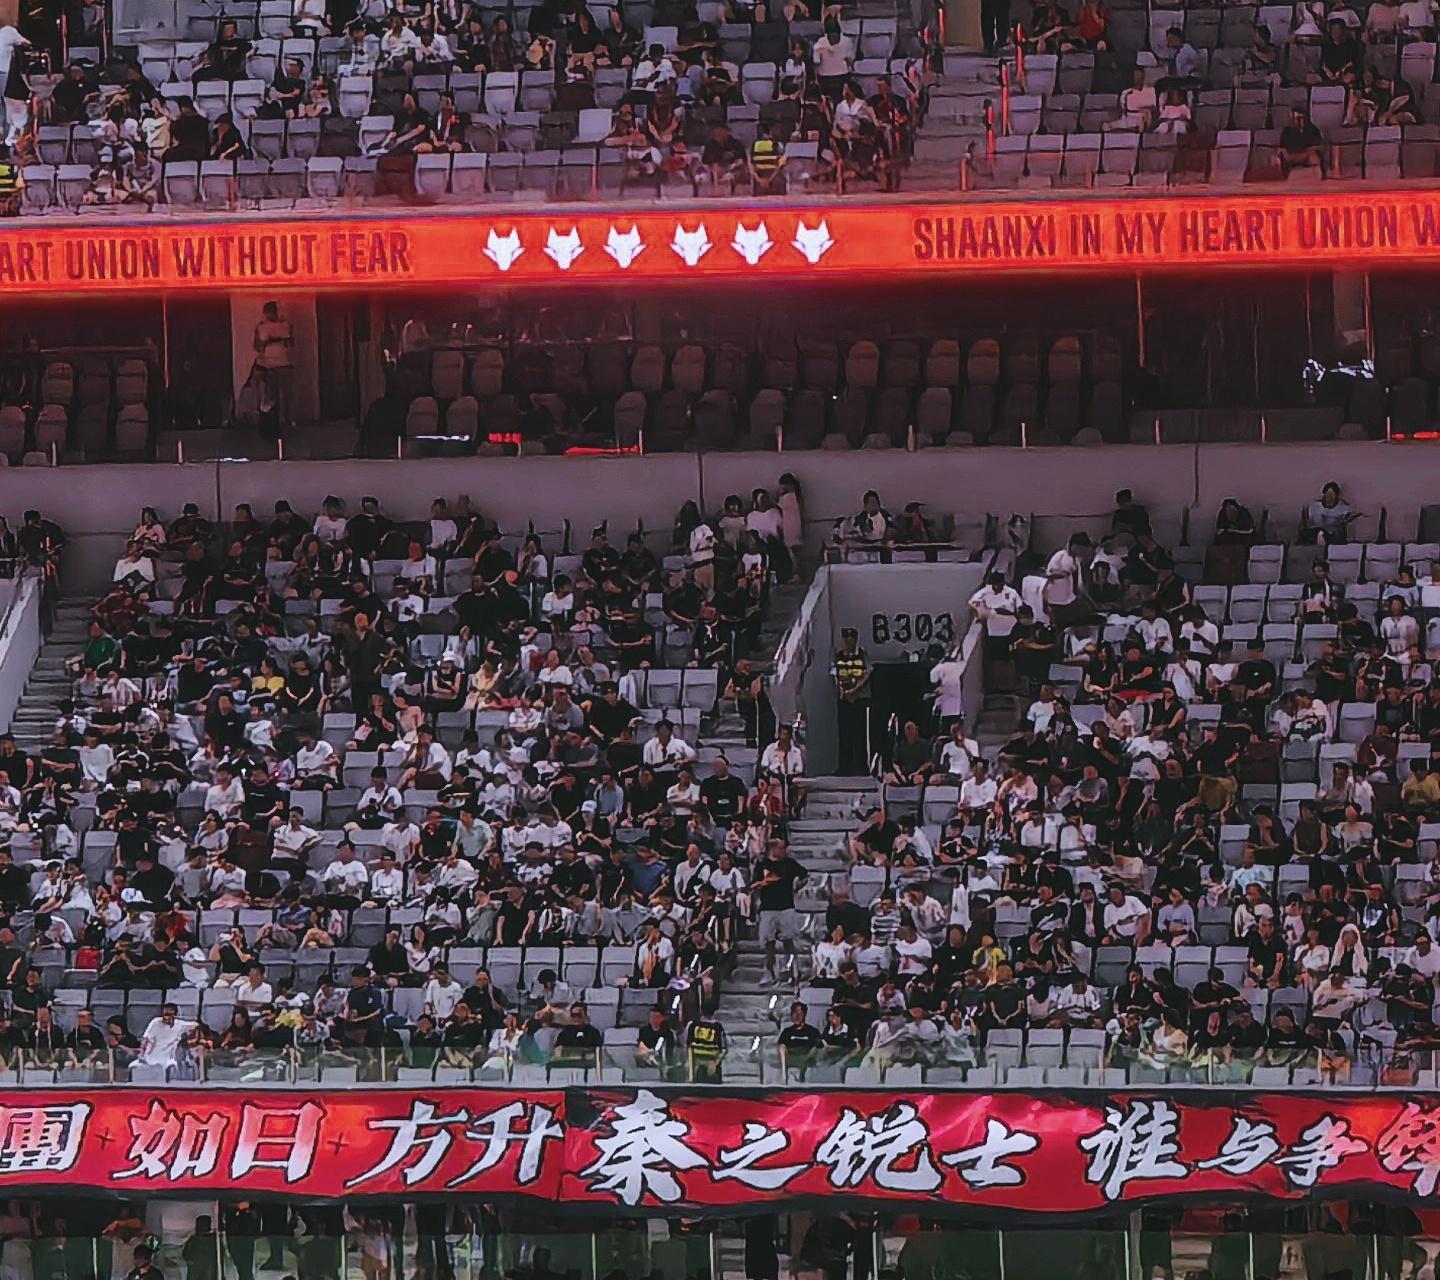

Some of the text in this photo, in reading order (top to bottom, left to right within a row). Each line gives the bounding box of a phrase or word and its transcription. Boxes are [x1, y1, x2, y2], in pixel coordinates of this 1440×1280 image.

[66, 236, 162, 280] UNION
[173, 233, 320, 278] WITHOUT
[330, 230, 411, 275] FEAR
[913, 213, 1057, 261] SHAANXI
[1068, 210, 1103, 257] IN
[1115, 209, 1167, 256] MY
[1178, 207, 1284, 254] HEART
[1297, 205, 1399, 249] UNION
